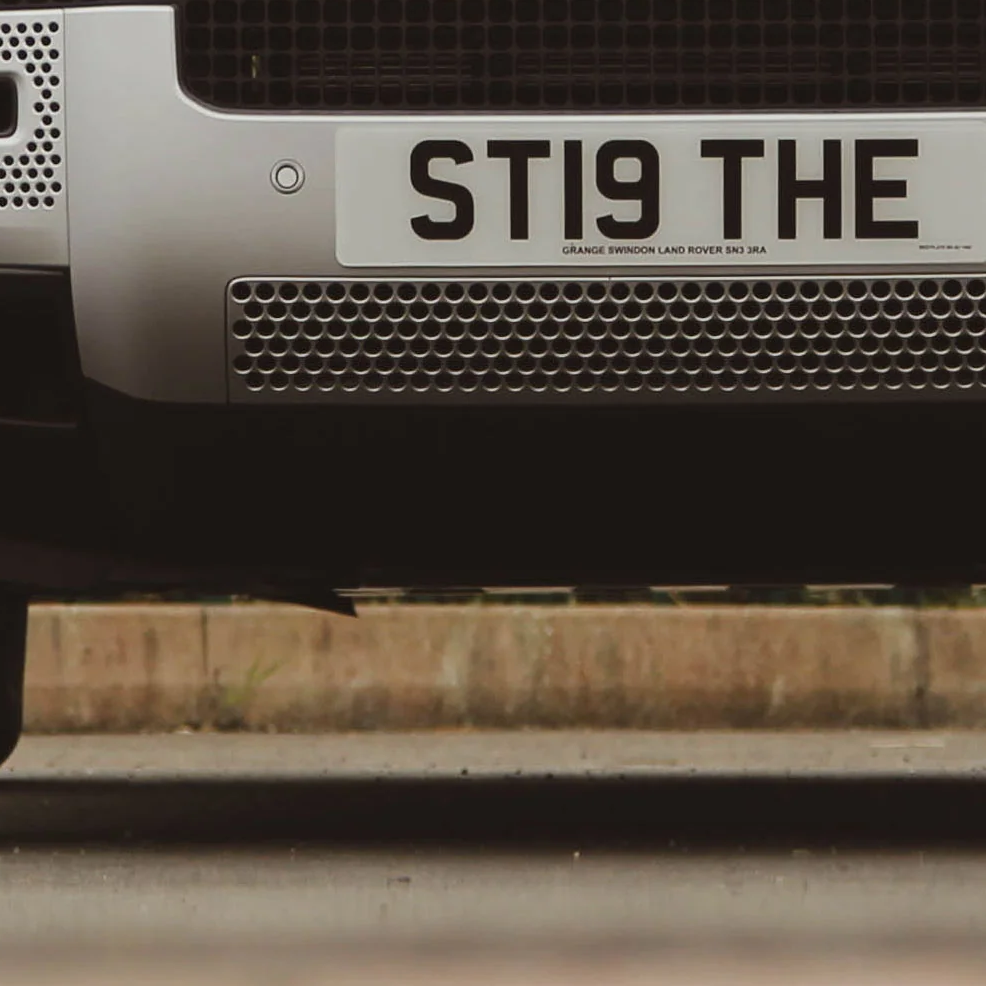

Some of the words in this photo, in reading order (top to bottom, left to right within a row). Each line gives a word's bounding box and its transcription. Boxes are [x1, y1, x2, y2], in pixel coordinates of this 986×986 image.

[700, 139, 919, 240] THE
[562, 245, 605, 255] GRANGE
[608, 245, 656, 255] SWINDON
[658, 245, 685, 255] LAND
[687, 245, 723, 255] ROVER
[725, 245, 745, 255] SN3
[747, 245, 767, 255] 3RA
